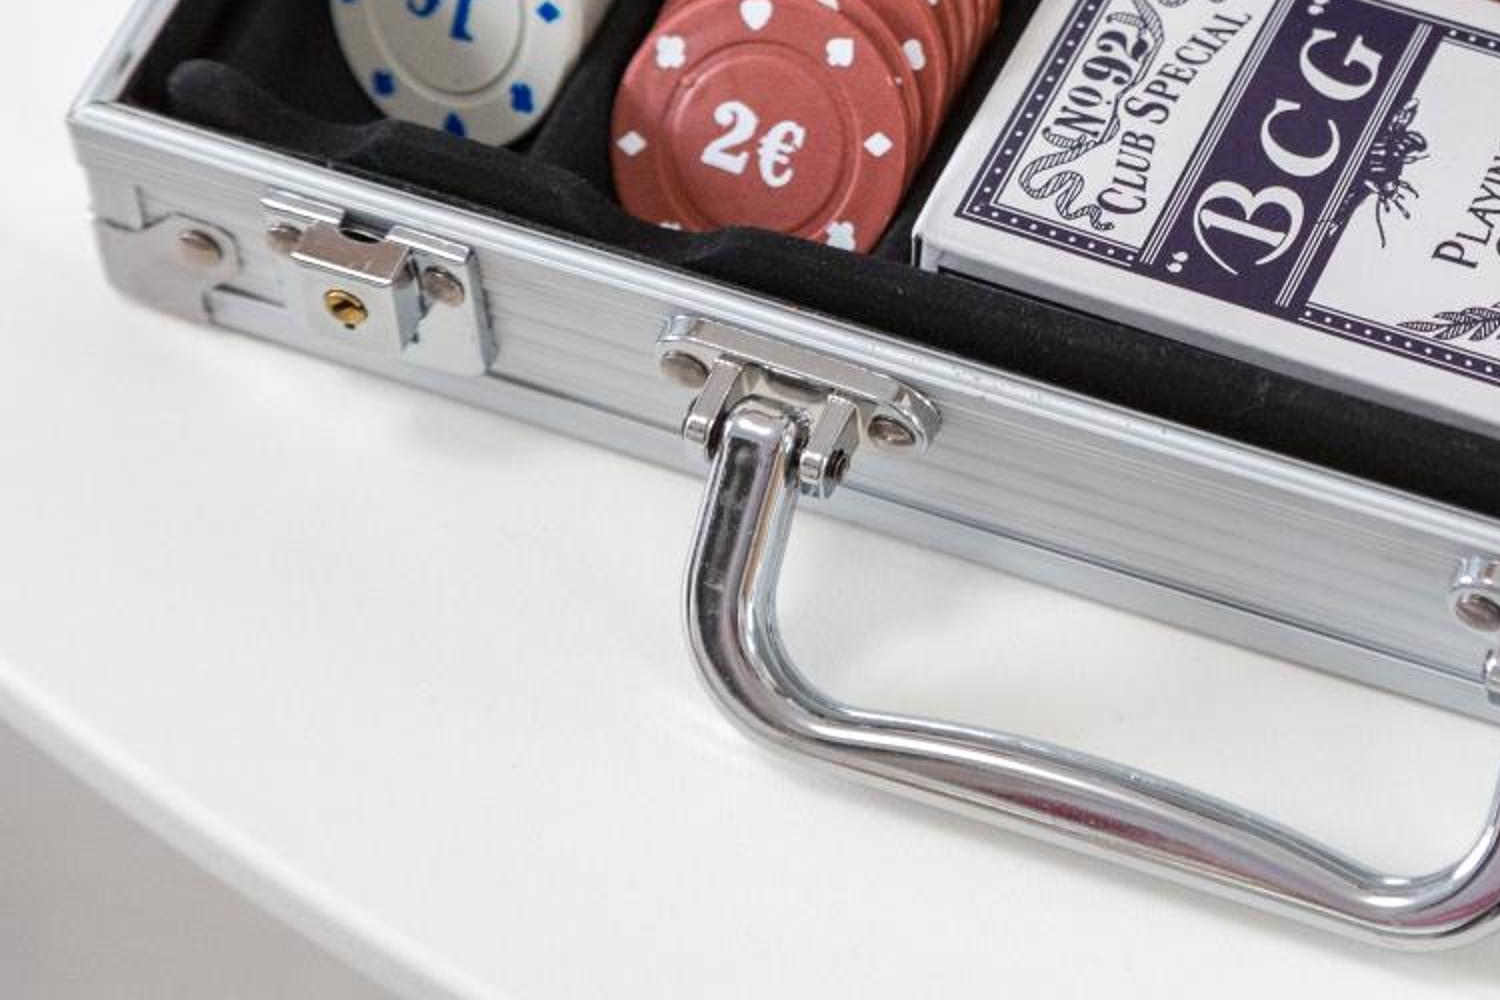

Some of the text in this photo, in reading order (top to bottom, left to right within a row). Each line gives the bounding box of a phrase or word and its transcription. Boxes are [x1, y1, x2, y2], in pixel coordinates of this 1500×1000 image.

[1081, 28, 1149, 86] 92
[700, 100, 806, 188] 2€
[1096, 10, 1252, 215] CLUB SPECIAL
